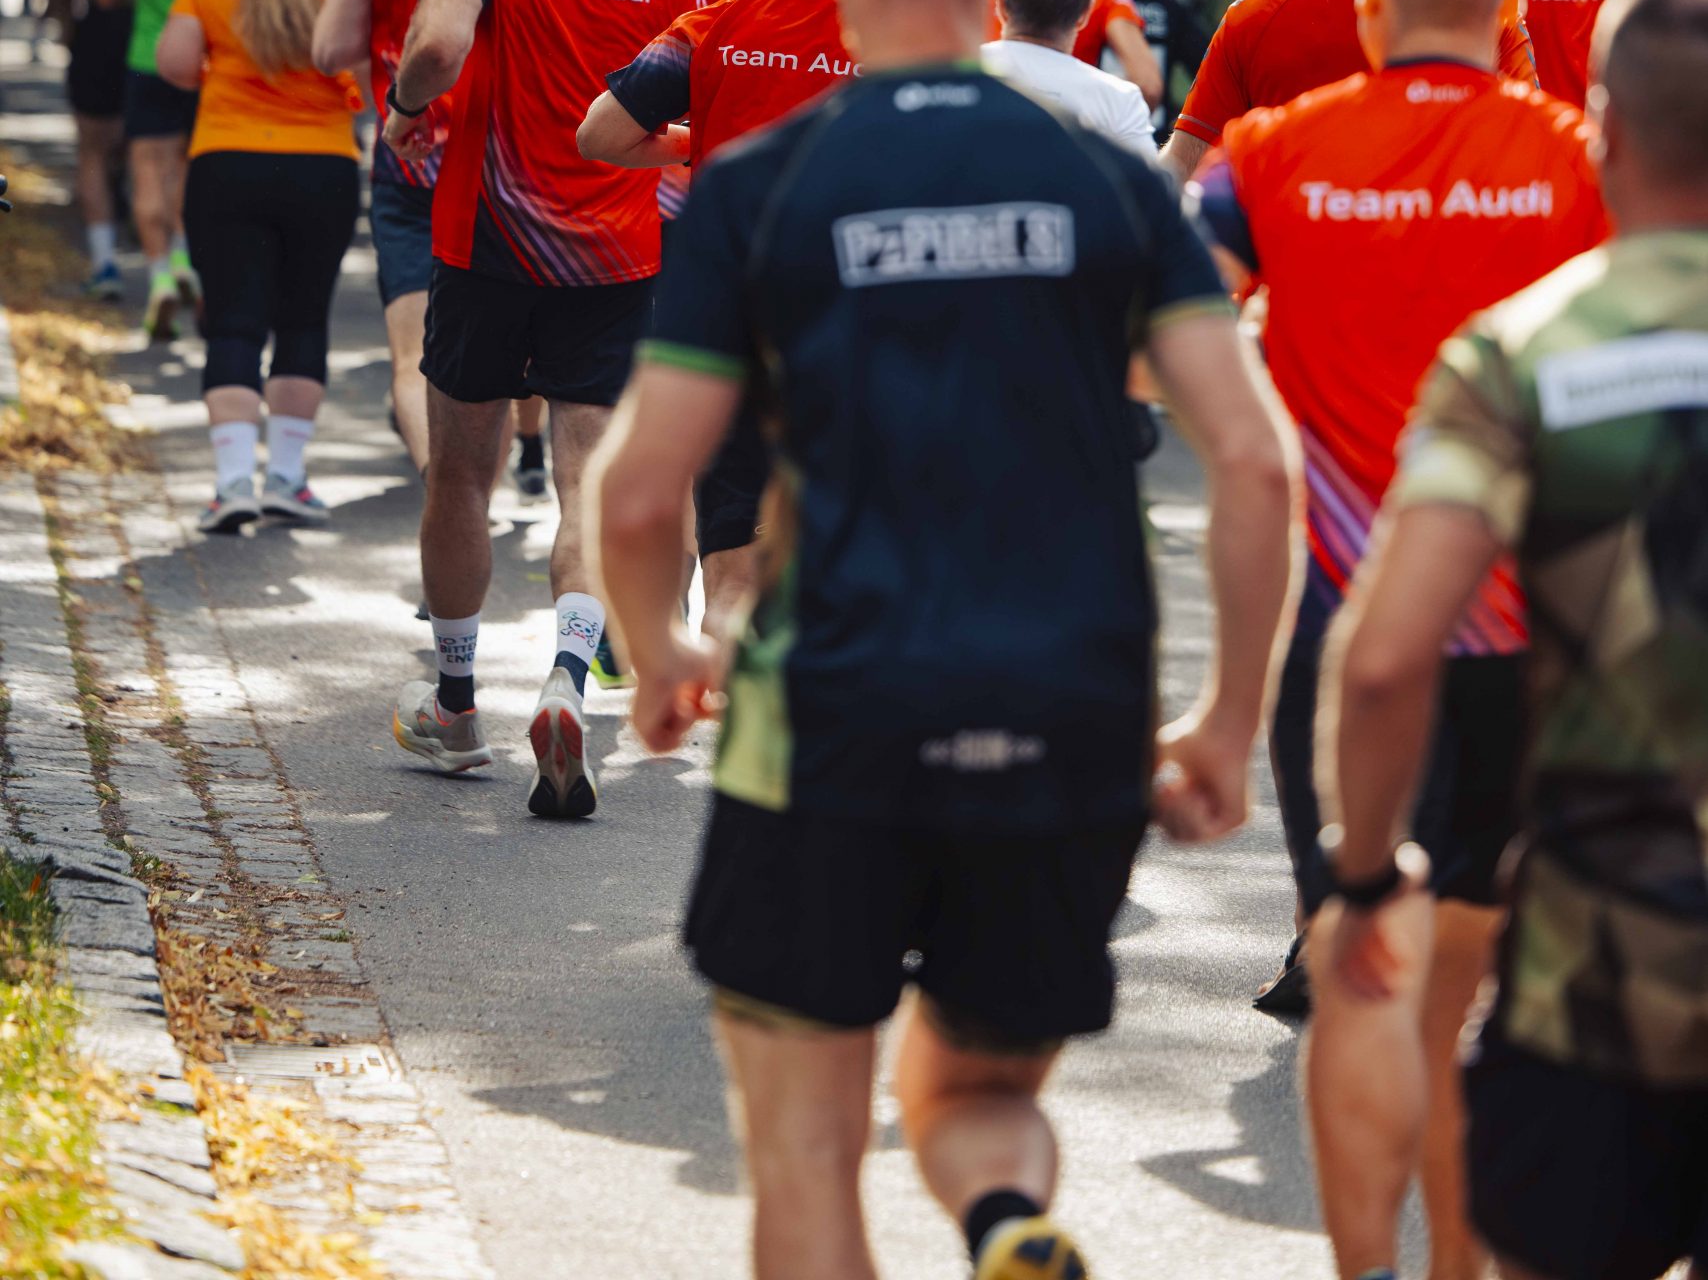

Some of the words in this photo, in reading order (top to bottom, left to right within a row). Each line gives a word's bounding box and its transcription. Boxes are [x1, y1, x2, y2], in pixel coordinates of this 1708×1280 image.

[718, 45, 798, 70] Team
[1300, 181, 1432, 221] Team
[1441, 179, 1553, 218] Audi
[437, 636, 456, 645] TO
[446, 652, 474, 663] END
